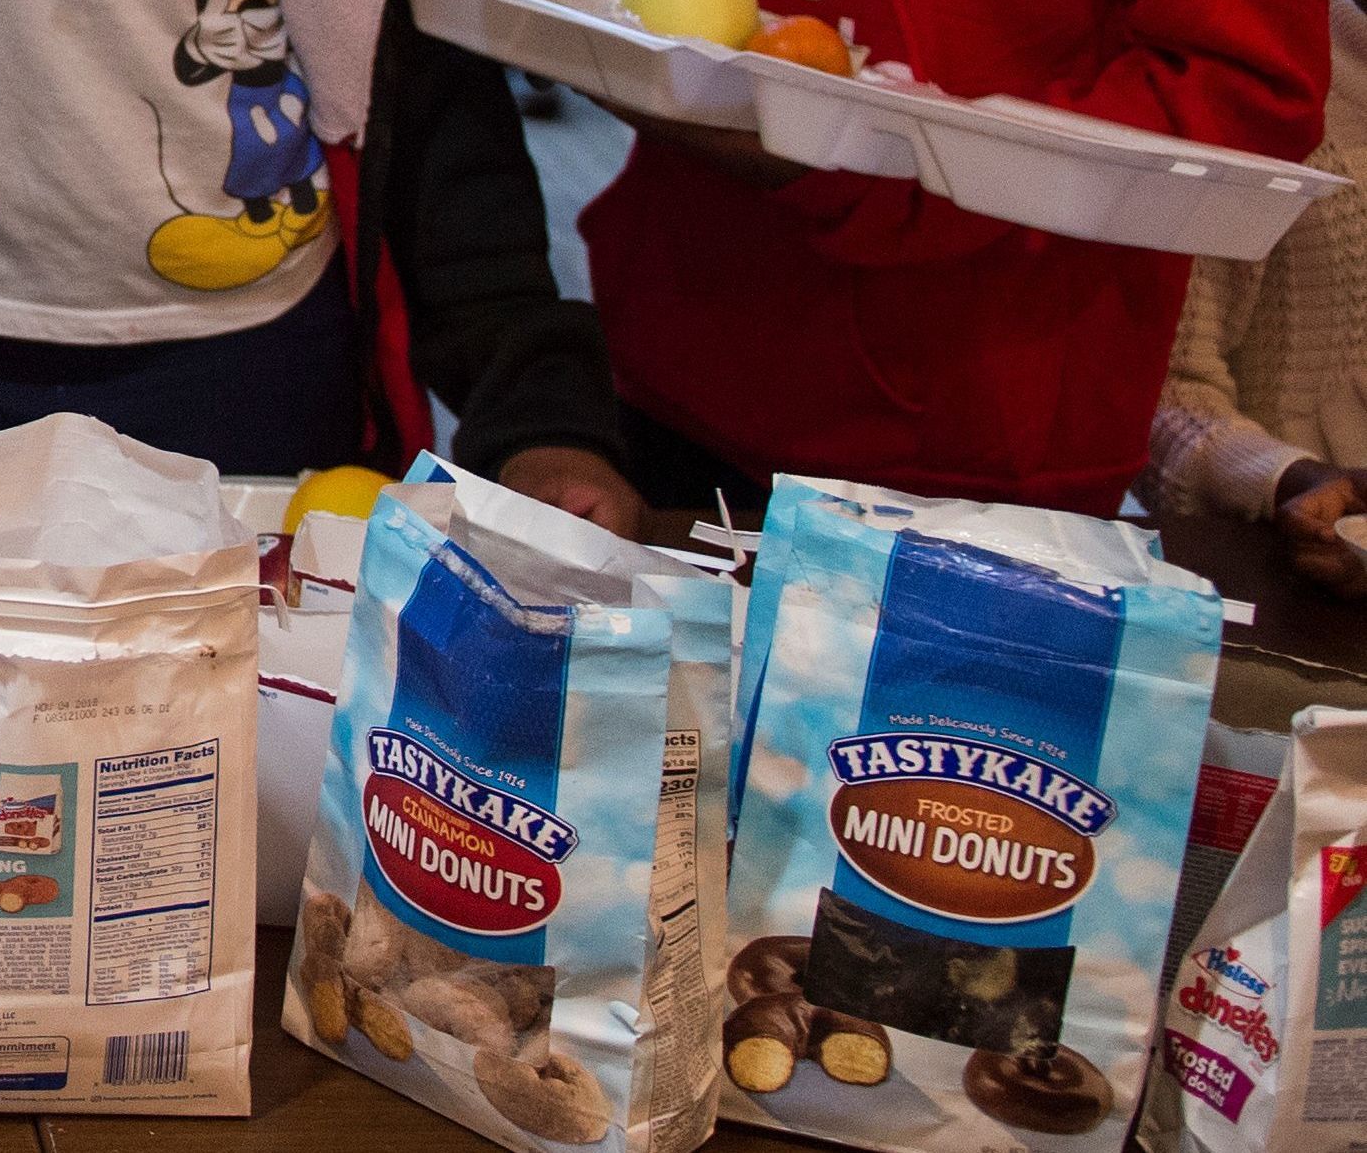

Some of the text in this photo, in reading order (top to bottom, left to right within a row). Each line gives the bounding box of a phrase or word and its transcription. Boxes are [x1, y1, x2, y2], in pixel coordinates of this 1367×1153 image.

[99, 746, 215, 774] Nutrition Facts
[888, 714, 1067, 761] Made Deliciously Since 1914
[373, 735, 570, 855] TASTYKAKE
[464, 756, 494, 777] Since
[498, 770, 527, 789] 1914
[838, 739, 1107, 829] TASTYKAKE
[402, 795, 496, 858] CINNAMON
[917, 798, 1015, 834] FROSTED
[368, 794, 416, 861] MINI
[420, 837, 546, 911] DONUTS
[843, 804, 1077, 889] MINI DONUTS
[1207, 947, 1267, 997] Hostess
[2, 1011, 16, 1020] LLC
[1171, 1037, 1236, 1091] Frosted
